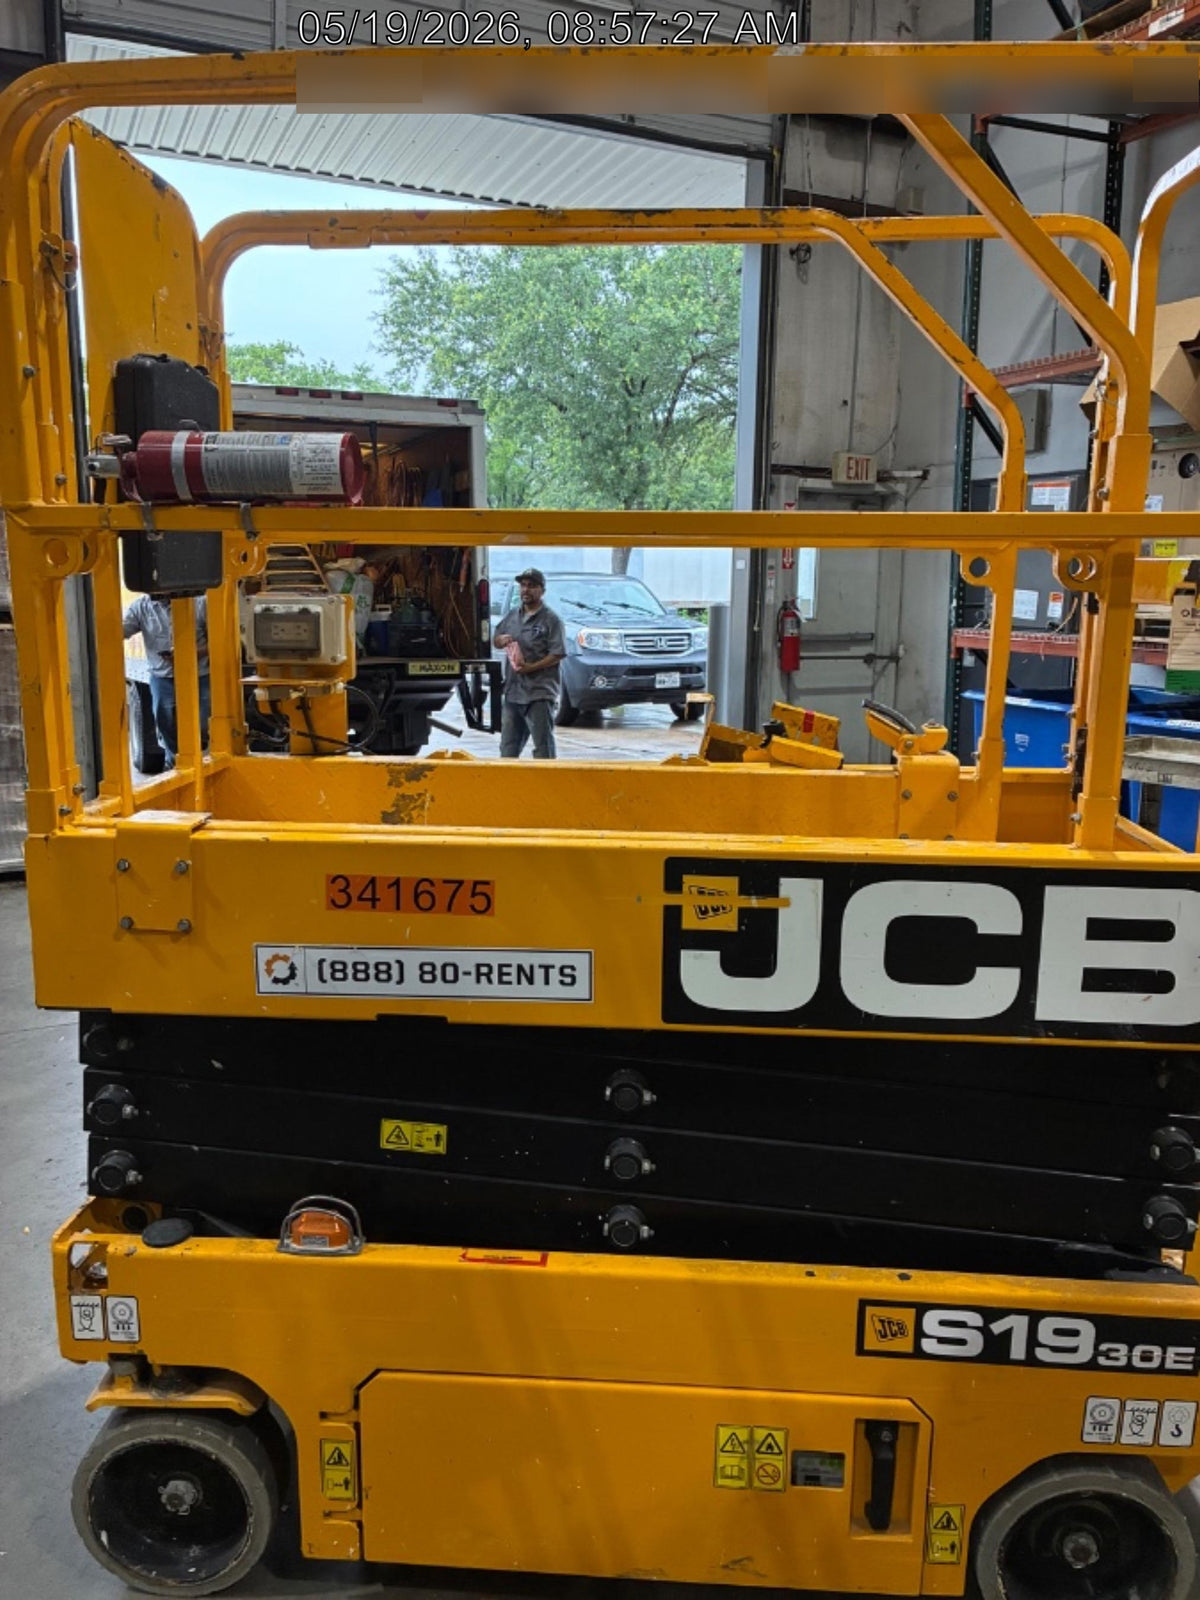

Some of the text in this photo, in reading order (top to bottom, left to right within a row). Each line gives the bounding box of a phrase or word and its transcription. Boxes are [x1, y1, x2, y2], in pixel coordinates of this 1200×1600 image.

[846, 456, 871, 481] EXIT
[329, 874, 493, 915] 341675
[680, 876, 1200, 1027] JCB
[317, 958, 577, 987] (888) 80-RENTS
[875, 1316, 907, 1340] JCB
